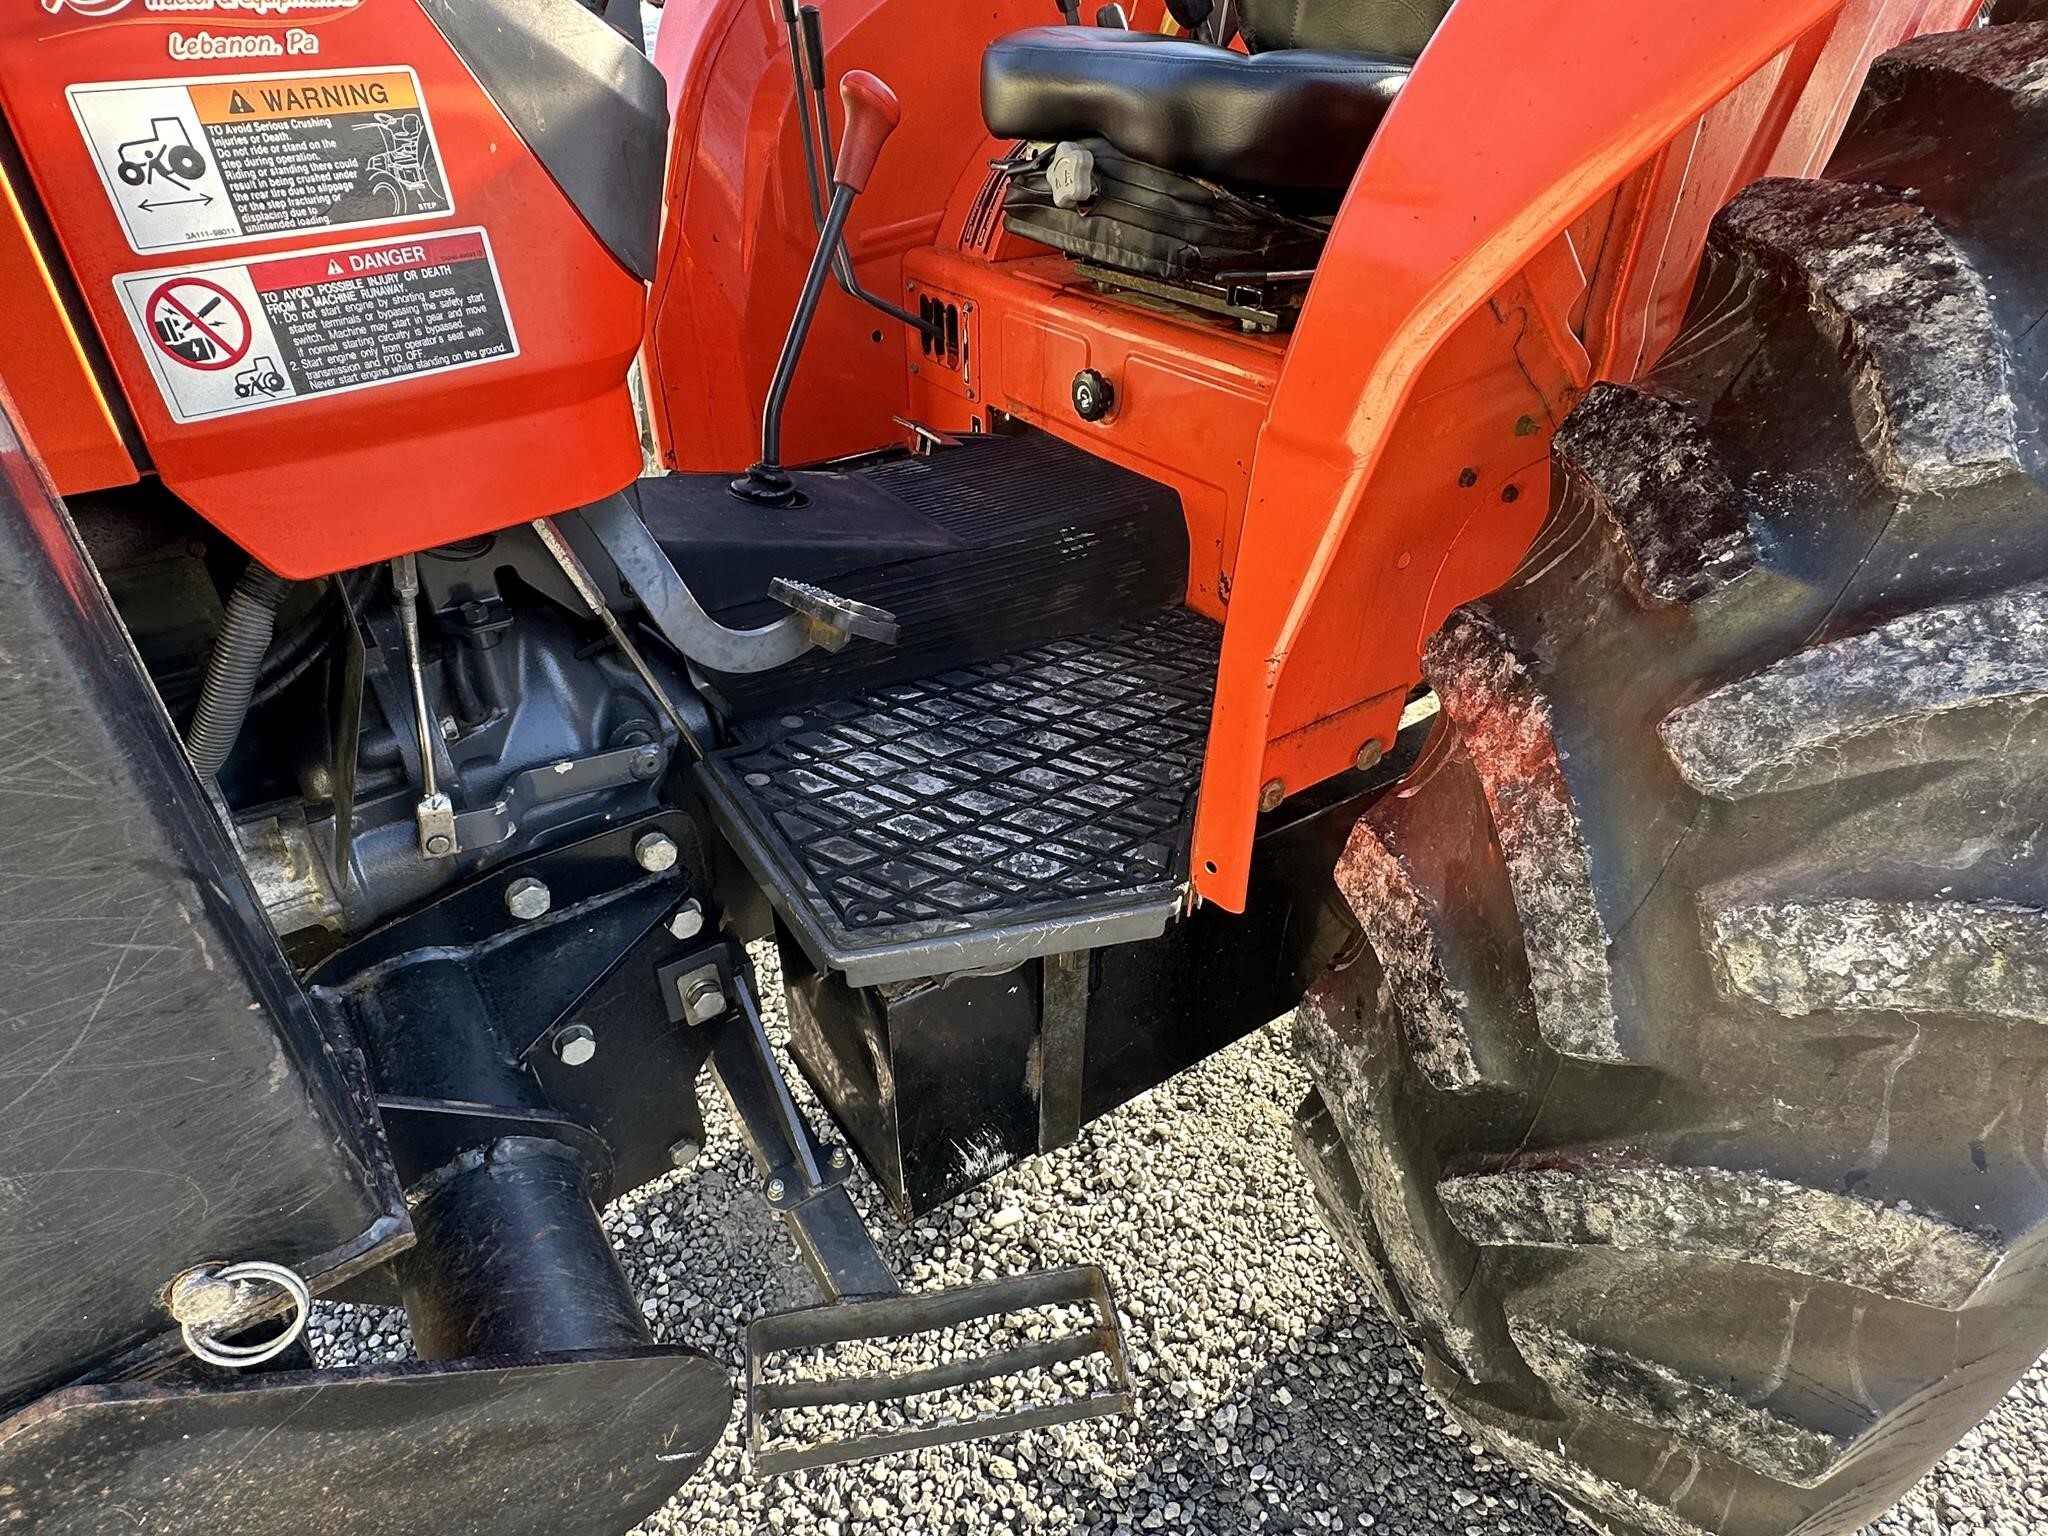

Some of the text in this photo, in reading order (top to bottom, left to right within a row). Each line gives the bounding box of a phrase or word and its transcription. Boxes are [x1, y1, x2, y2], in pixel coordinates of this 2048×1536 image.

[169, 28, 319, 59] Lebanon, Pa
[260, 83, 388, 112] WARNING
[207, 117, 332, 136] TO Avoid Serious Crushing
[212, 132, 292, 148] Injuries or Death.
[216, 139, 337, 158] Do not ride or stand on the
[221, 152, 321, 169] step during operation.
[224, 158, 359, 180] Riding or standing there could
[229, 170, 357, 191] result in being crushed under
[233, 182, 354, 202] the rear tire due to slippage
[238, 194, 341, 212] or the step fracturing or
[242, 207, 318, 224] displacing due to
[418, 202, 436, 210] STEP
[245, 219, 296, 233] unintended
[349, 246, 426, 271] DANGER
[261, 265, 452, 303] TO AVOID POSSIBLE INJURY OR DEATH
[266, 283, 408, 315] FROM A MACHINE RUNAWAY.
[271, 288, 455, 325] 1. Do not start engine by shorting across
[288, 293, 485, 334] starter terminals or bypassing the safety start
[293, 305, 487, 346] switch. Machine may start in gear and move
[290, 327, 484, 371] 2. Start engine only from operator's seat with
[297, 319, 465, 357] if normal starting circuitry is bypassed.
[306, 363, 361, 380] transmission
[364, 356, 381, 369] and
[383, 353, 403, 365] PTO
[309, 343, 506, 390] Never start engine while standing on the ground.
